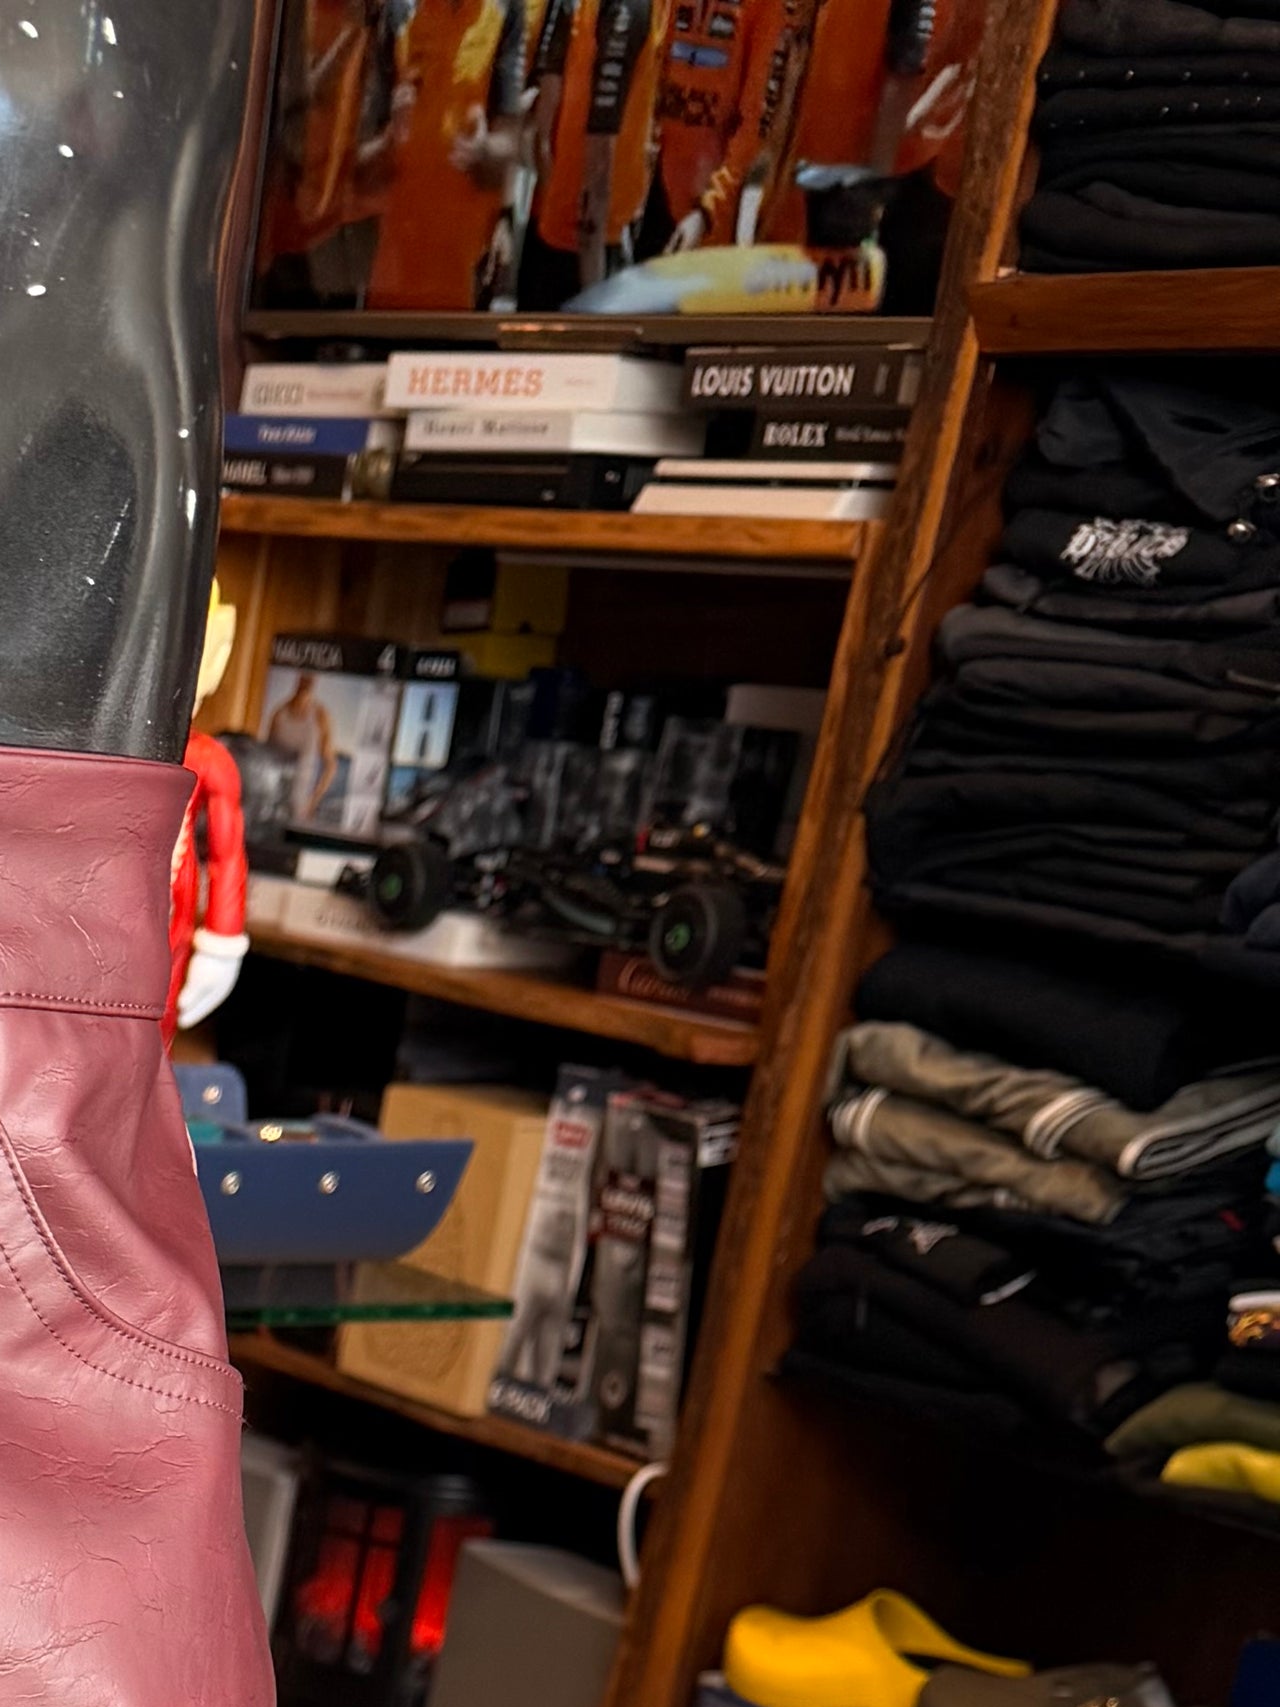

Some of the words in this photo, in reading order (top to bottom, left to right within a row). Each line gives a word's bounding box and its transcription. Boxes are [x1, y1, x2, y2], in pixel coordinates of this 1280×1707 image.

[691, 364, 755, 397] LOUIS
[759, 364, 856, 397] VUITTON
[762, 421, 829, 448] ROLEX
